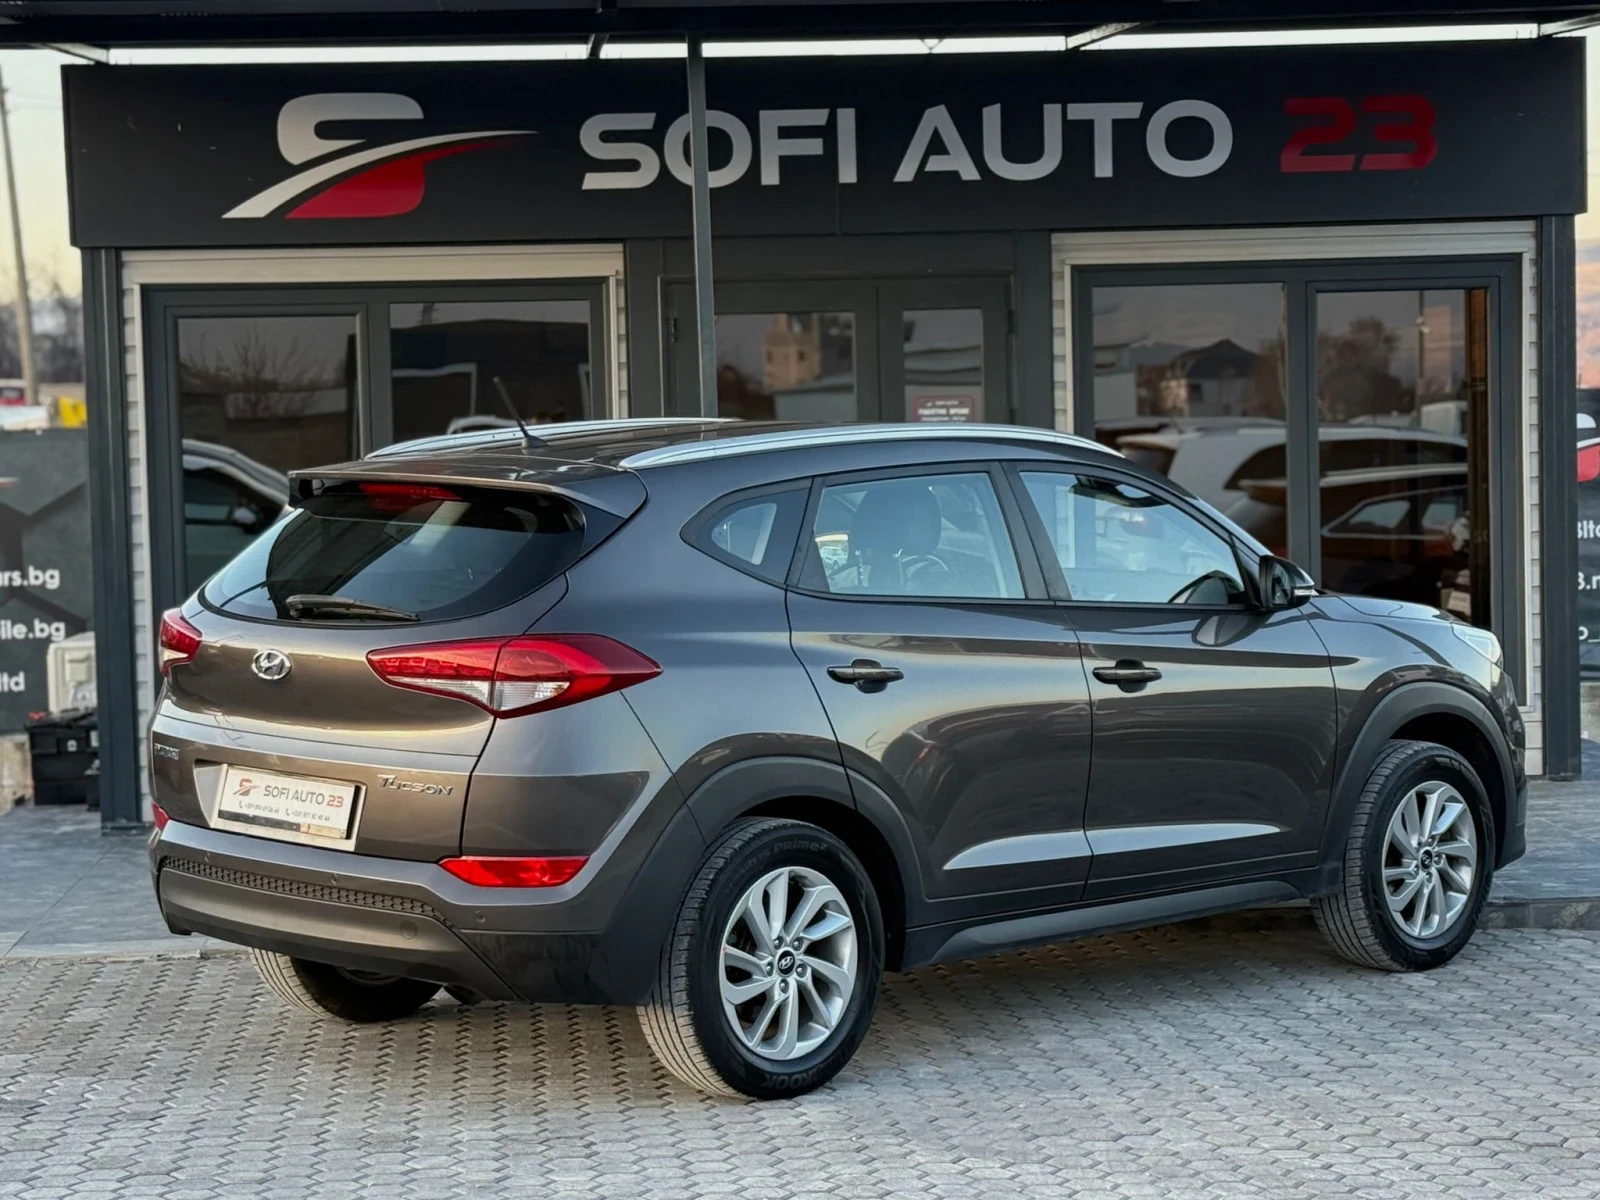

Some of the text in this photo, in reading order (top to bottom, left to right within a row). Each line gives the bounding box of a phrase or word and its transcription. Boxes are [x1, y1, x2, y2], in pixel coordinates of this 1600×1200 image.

[579, 94, 1438, 190] SOFI AUTO 23
[0, 565, 61, 590] rs.bg
[263, 784, 345, 809] SOFI AUTO 23
